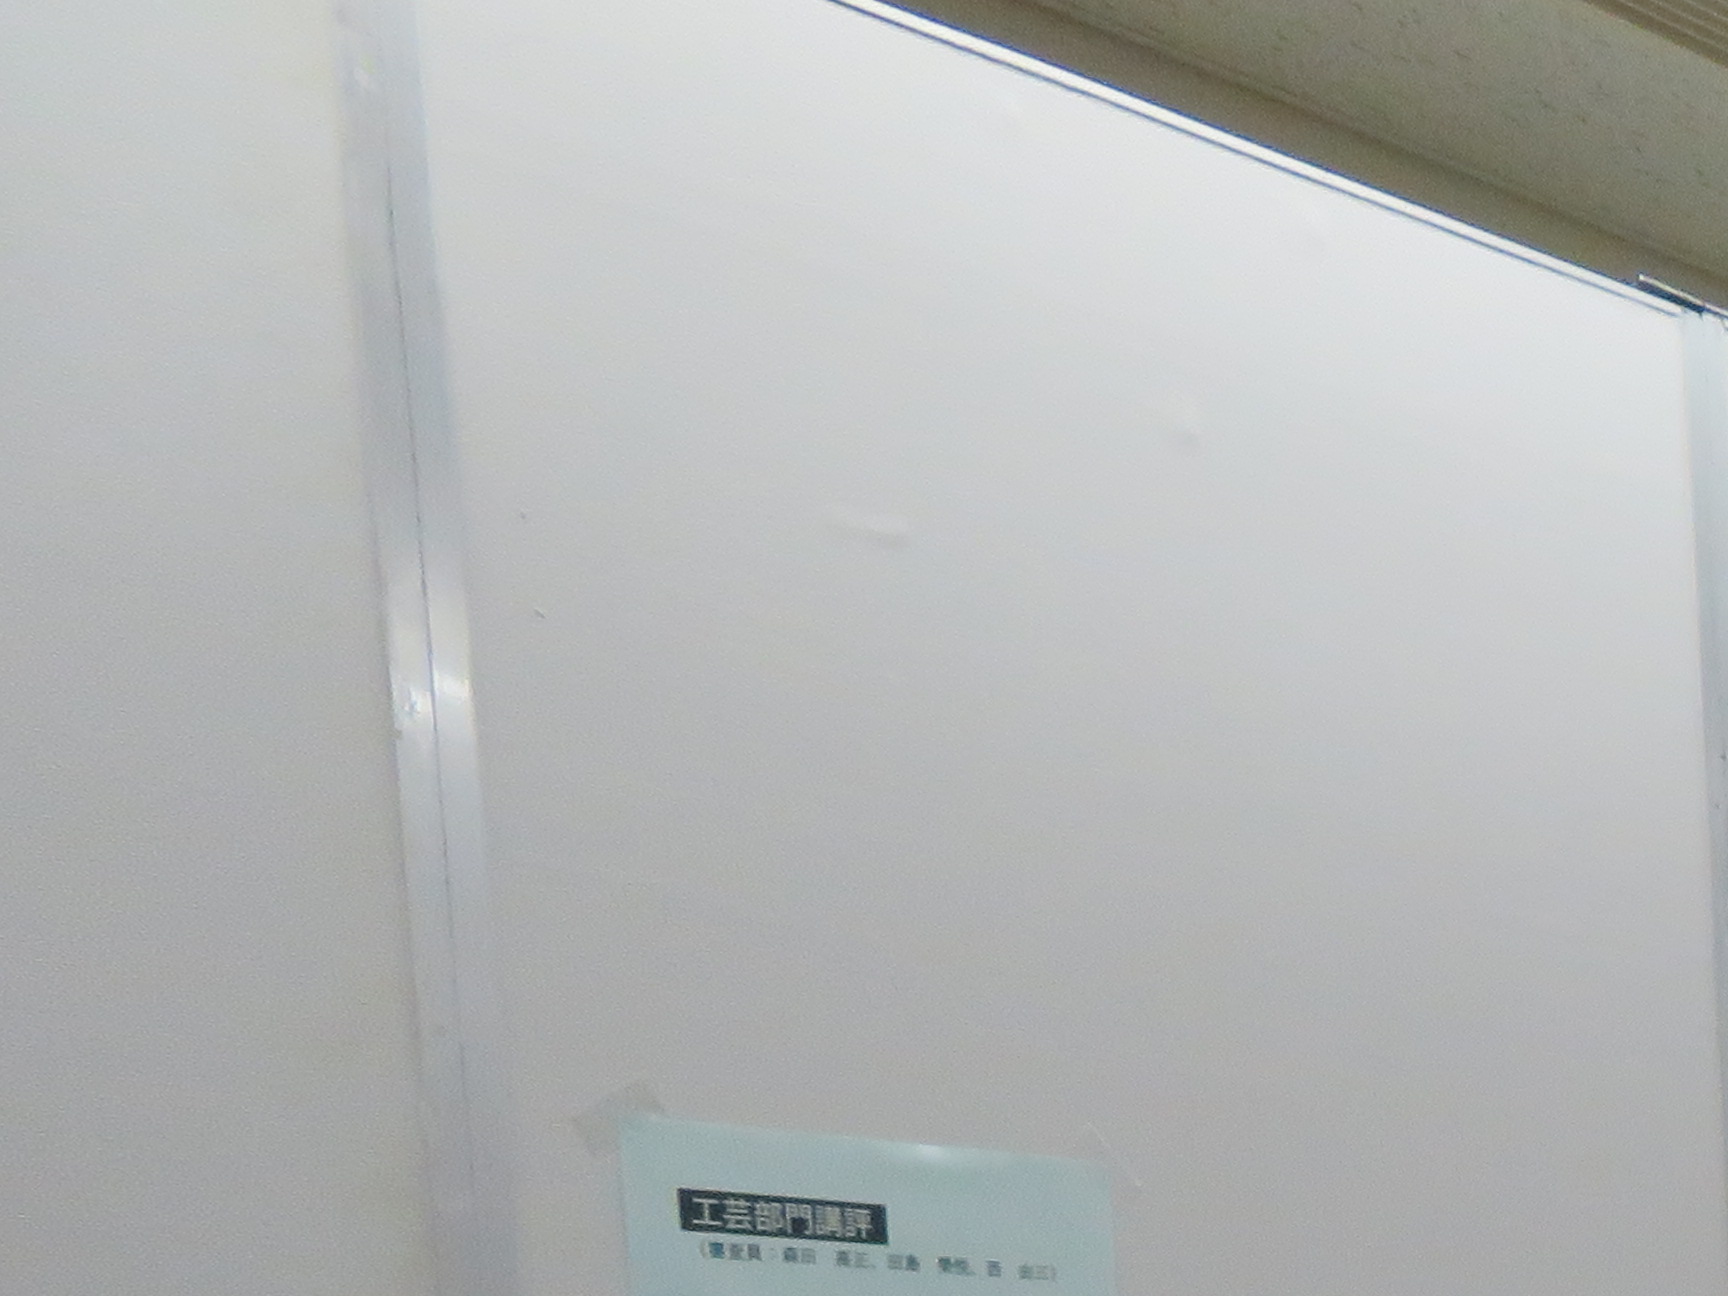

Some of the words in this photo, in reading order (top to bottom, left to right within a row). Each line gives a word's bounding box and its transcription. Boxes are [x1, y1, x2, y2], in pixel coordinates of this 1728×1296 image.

[692, 1197, 874, 1240] 工芸部門講評
